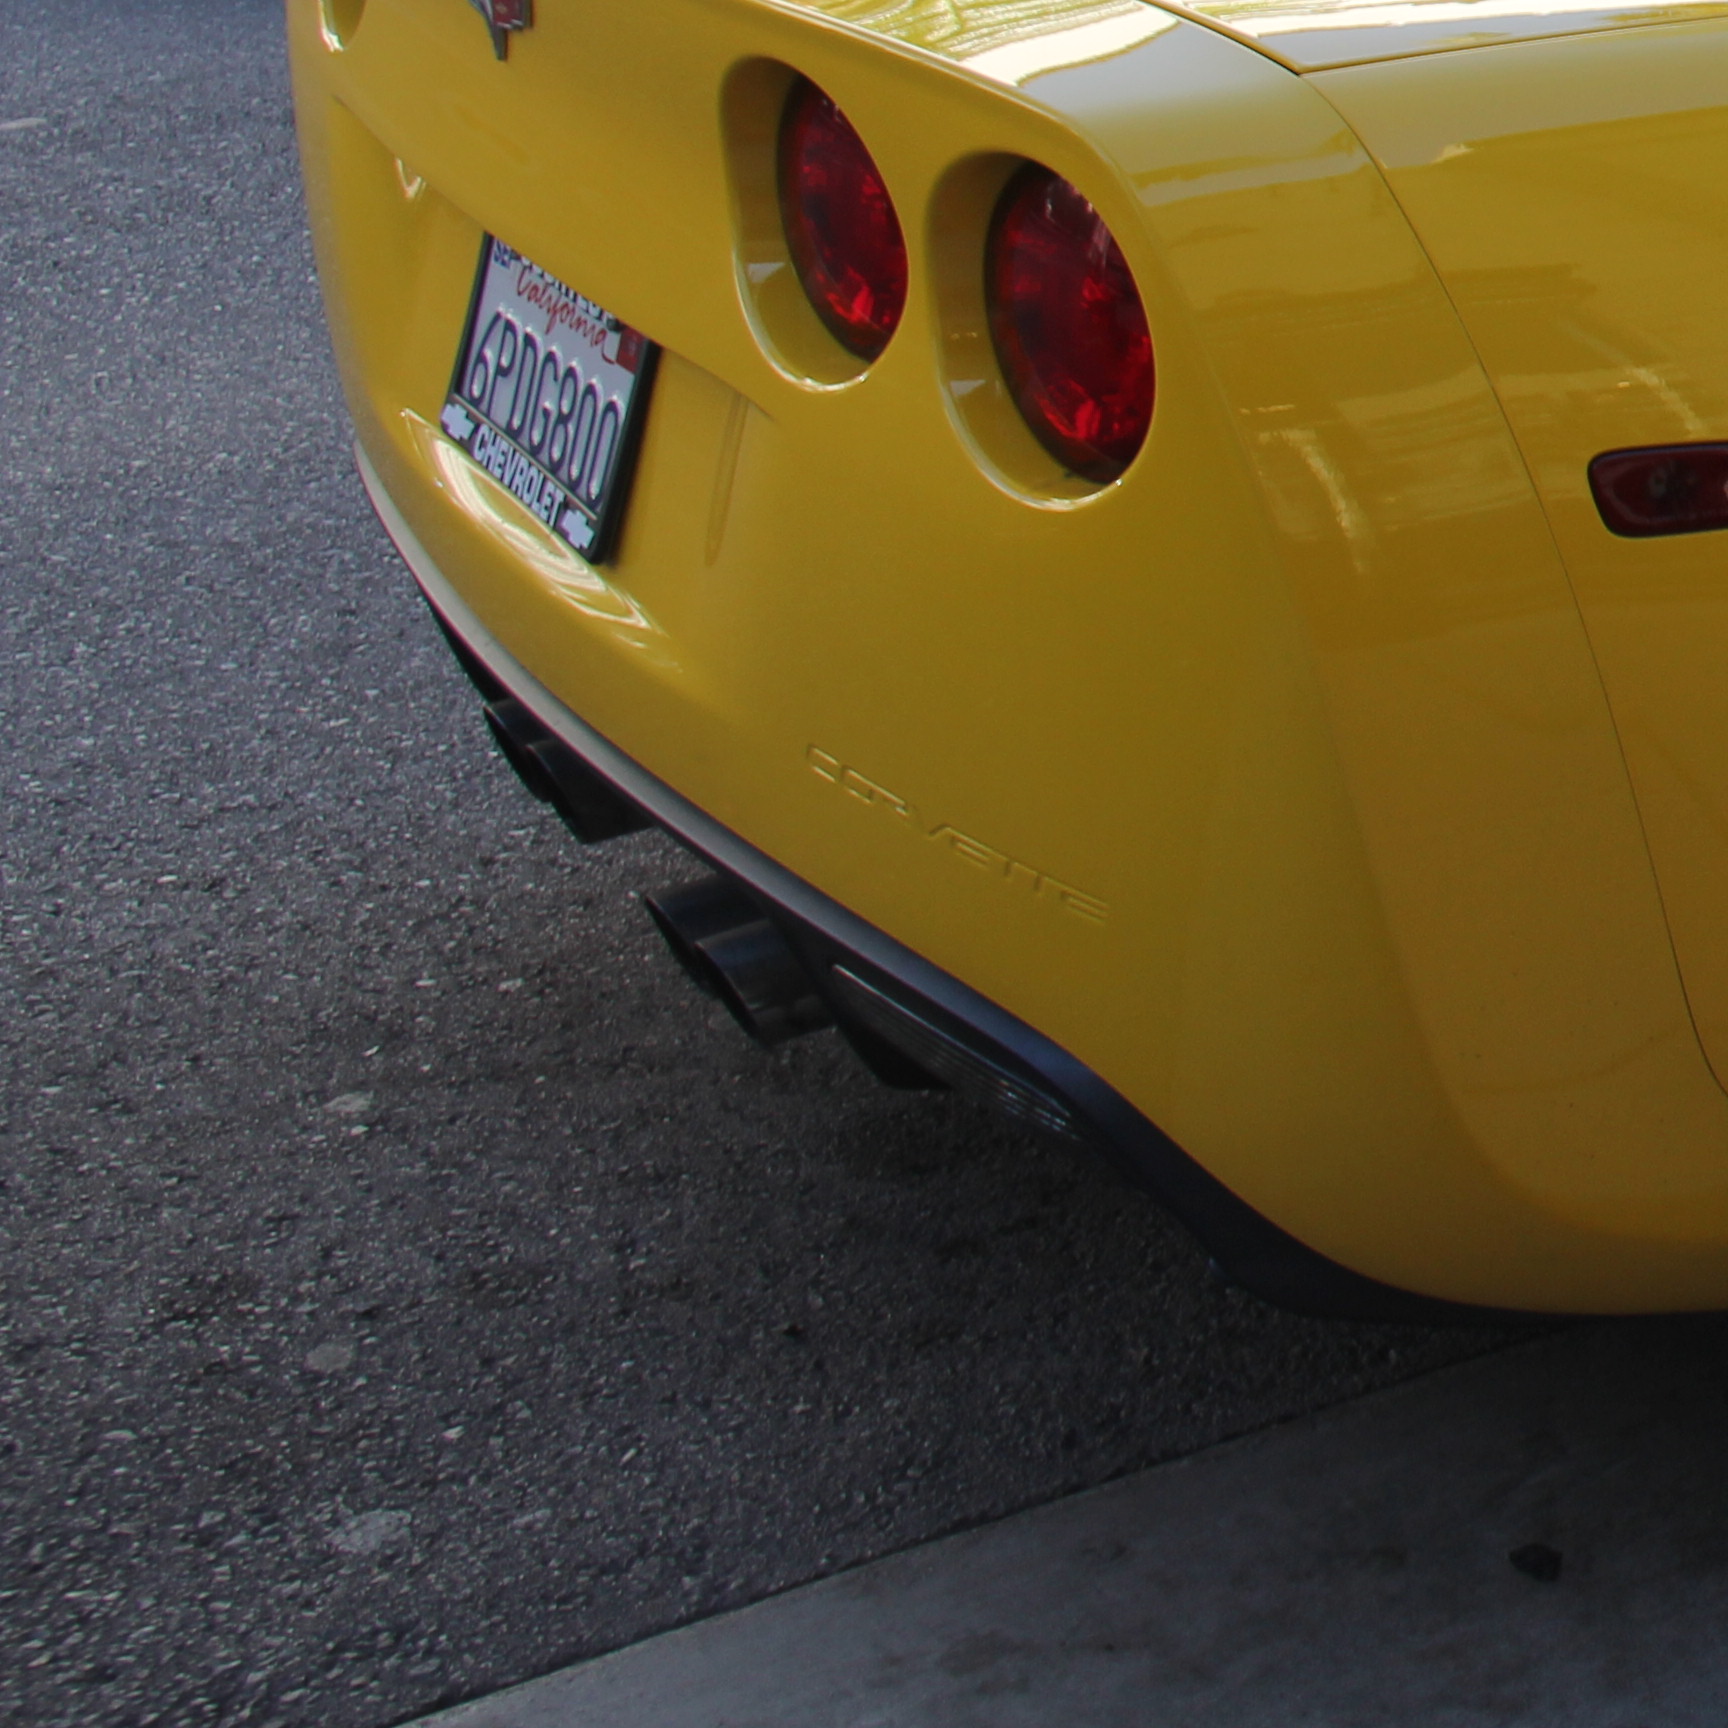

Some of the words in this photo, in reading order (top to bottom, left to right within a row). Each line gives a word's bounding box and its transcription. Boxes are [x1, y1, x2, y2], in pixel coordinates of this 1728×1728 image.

[468, 308, 621, 510] 6PDG800
[473, 423, 565, 527] CHEVROLET
[805, 743, 1110, 925] CORVETTE
